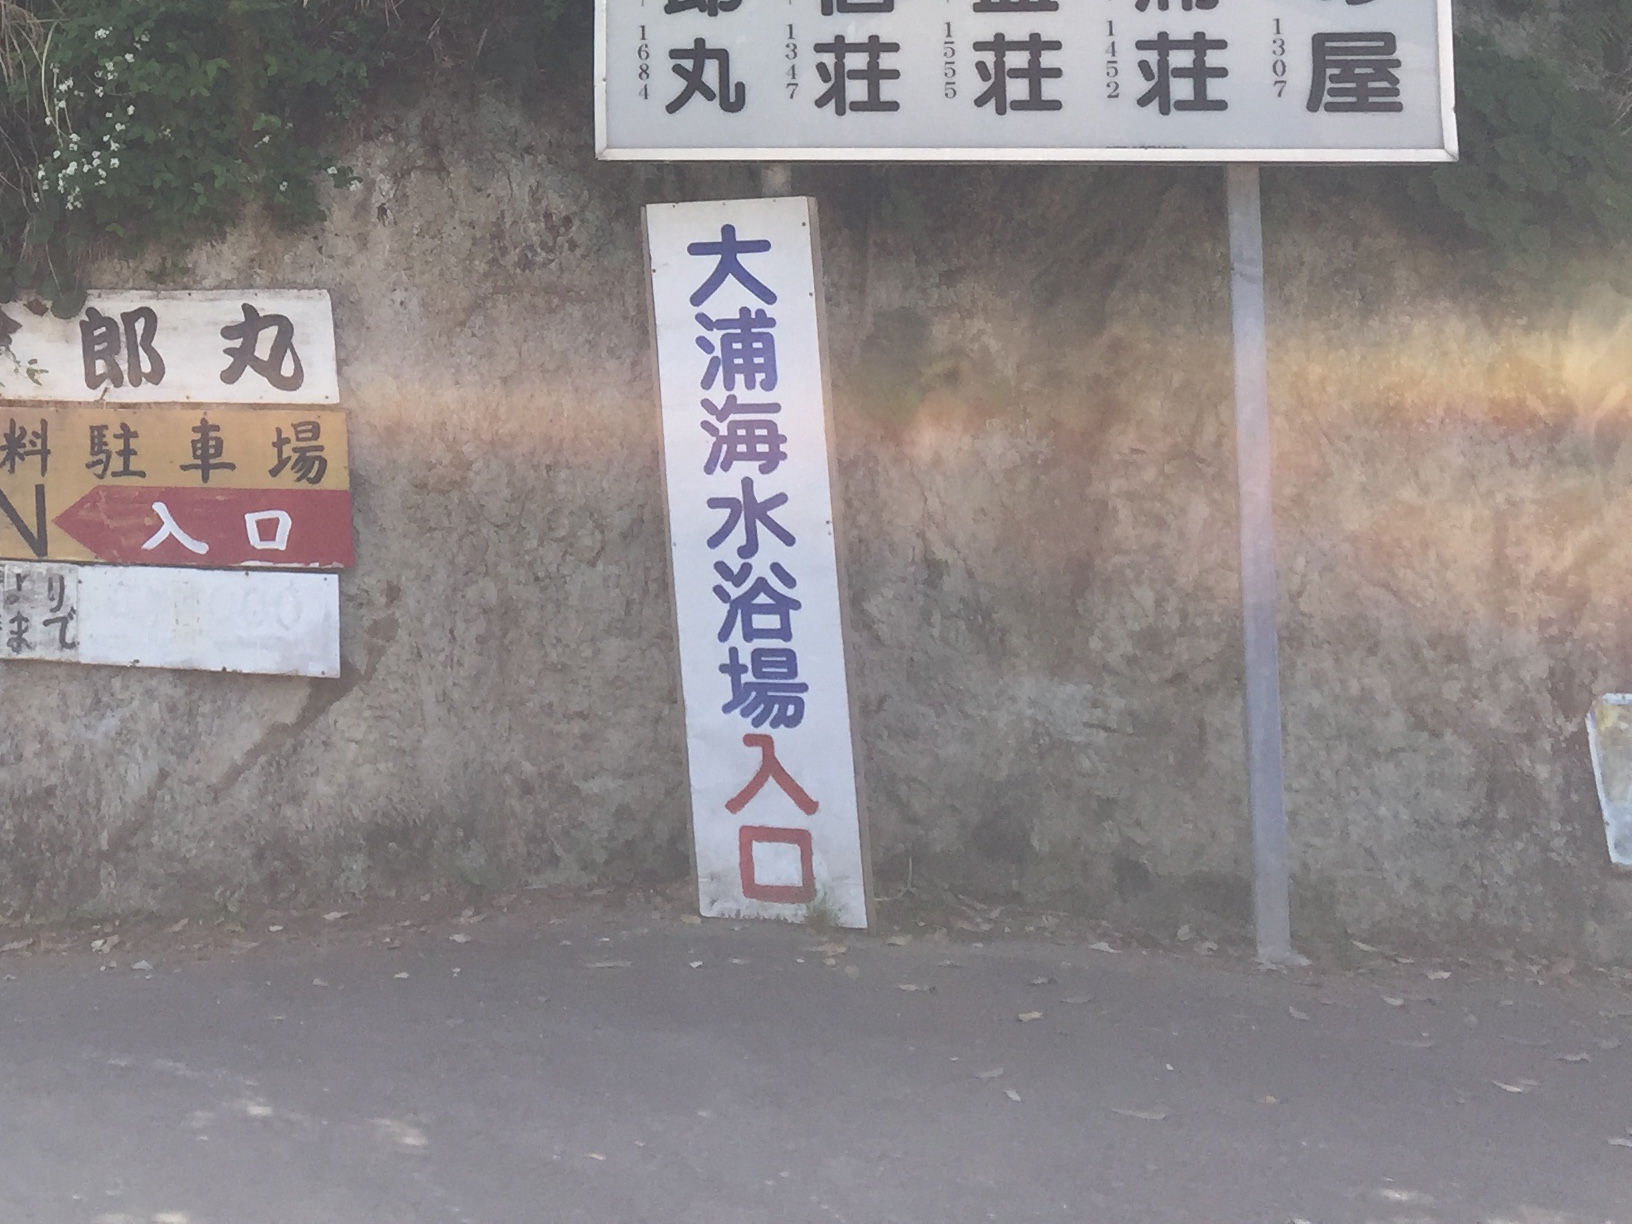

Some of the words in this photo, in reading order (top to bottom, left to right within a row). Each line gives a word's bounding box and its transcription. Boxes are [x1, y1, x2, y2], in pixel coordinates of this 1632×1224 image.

[141, 501, 293, 555] 入口
[687, 224, 820, 905] 大浦海水浴場入口
